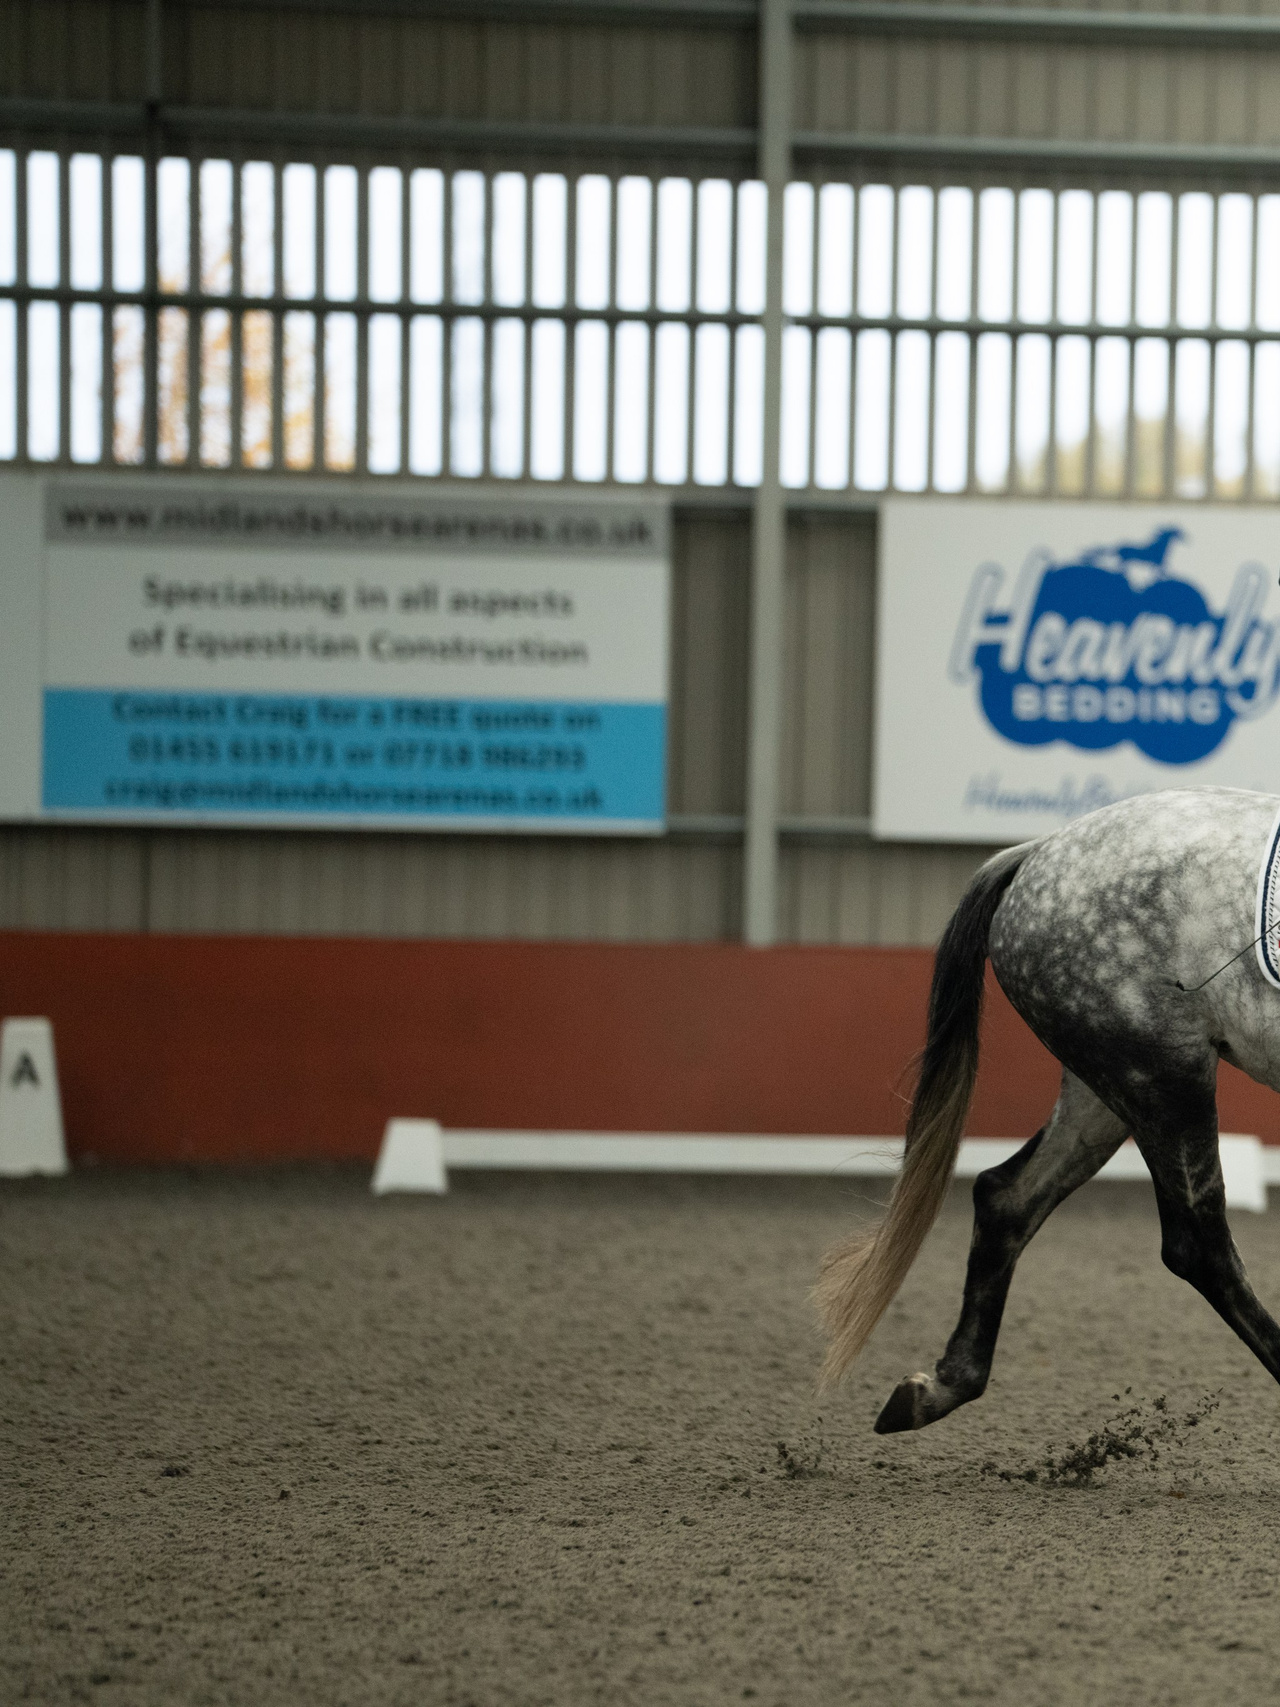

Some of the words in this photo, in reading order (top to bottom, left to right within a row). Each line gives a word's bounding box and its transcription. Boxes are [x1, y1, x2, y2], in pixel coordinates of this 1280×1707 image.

[141, 576, 348, 617] Specialising
[353, 580, 390, 611] in
[396, 581, 439, 613] all
[447, 586, 577, 621] aspects
[126, 625, 168, 656] of
[174, 625, 363, 664] Equestrian
[367, 628, 591, 667] Construction
[109, 695, 229, 724] Contact
[233, 697, 310, 730] Craig
[316, 699, 360, 727] for
[366, 706, 385, 727] a
[391, 702, 463, 730] FREE
[469, 705, 556, 735] quote
[562, 709, 602, 732] on
[1011, 683, 1221, 724] BEDDING
[343, 744, 376, 768] or
[10, 1049, 41, 1090] A
